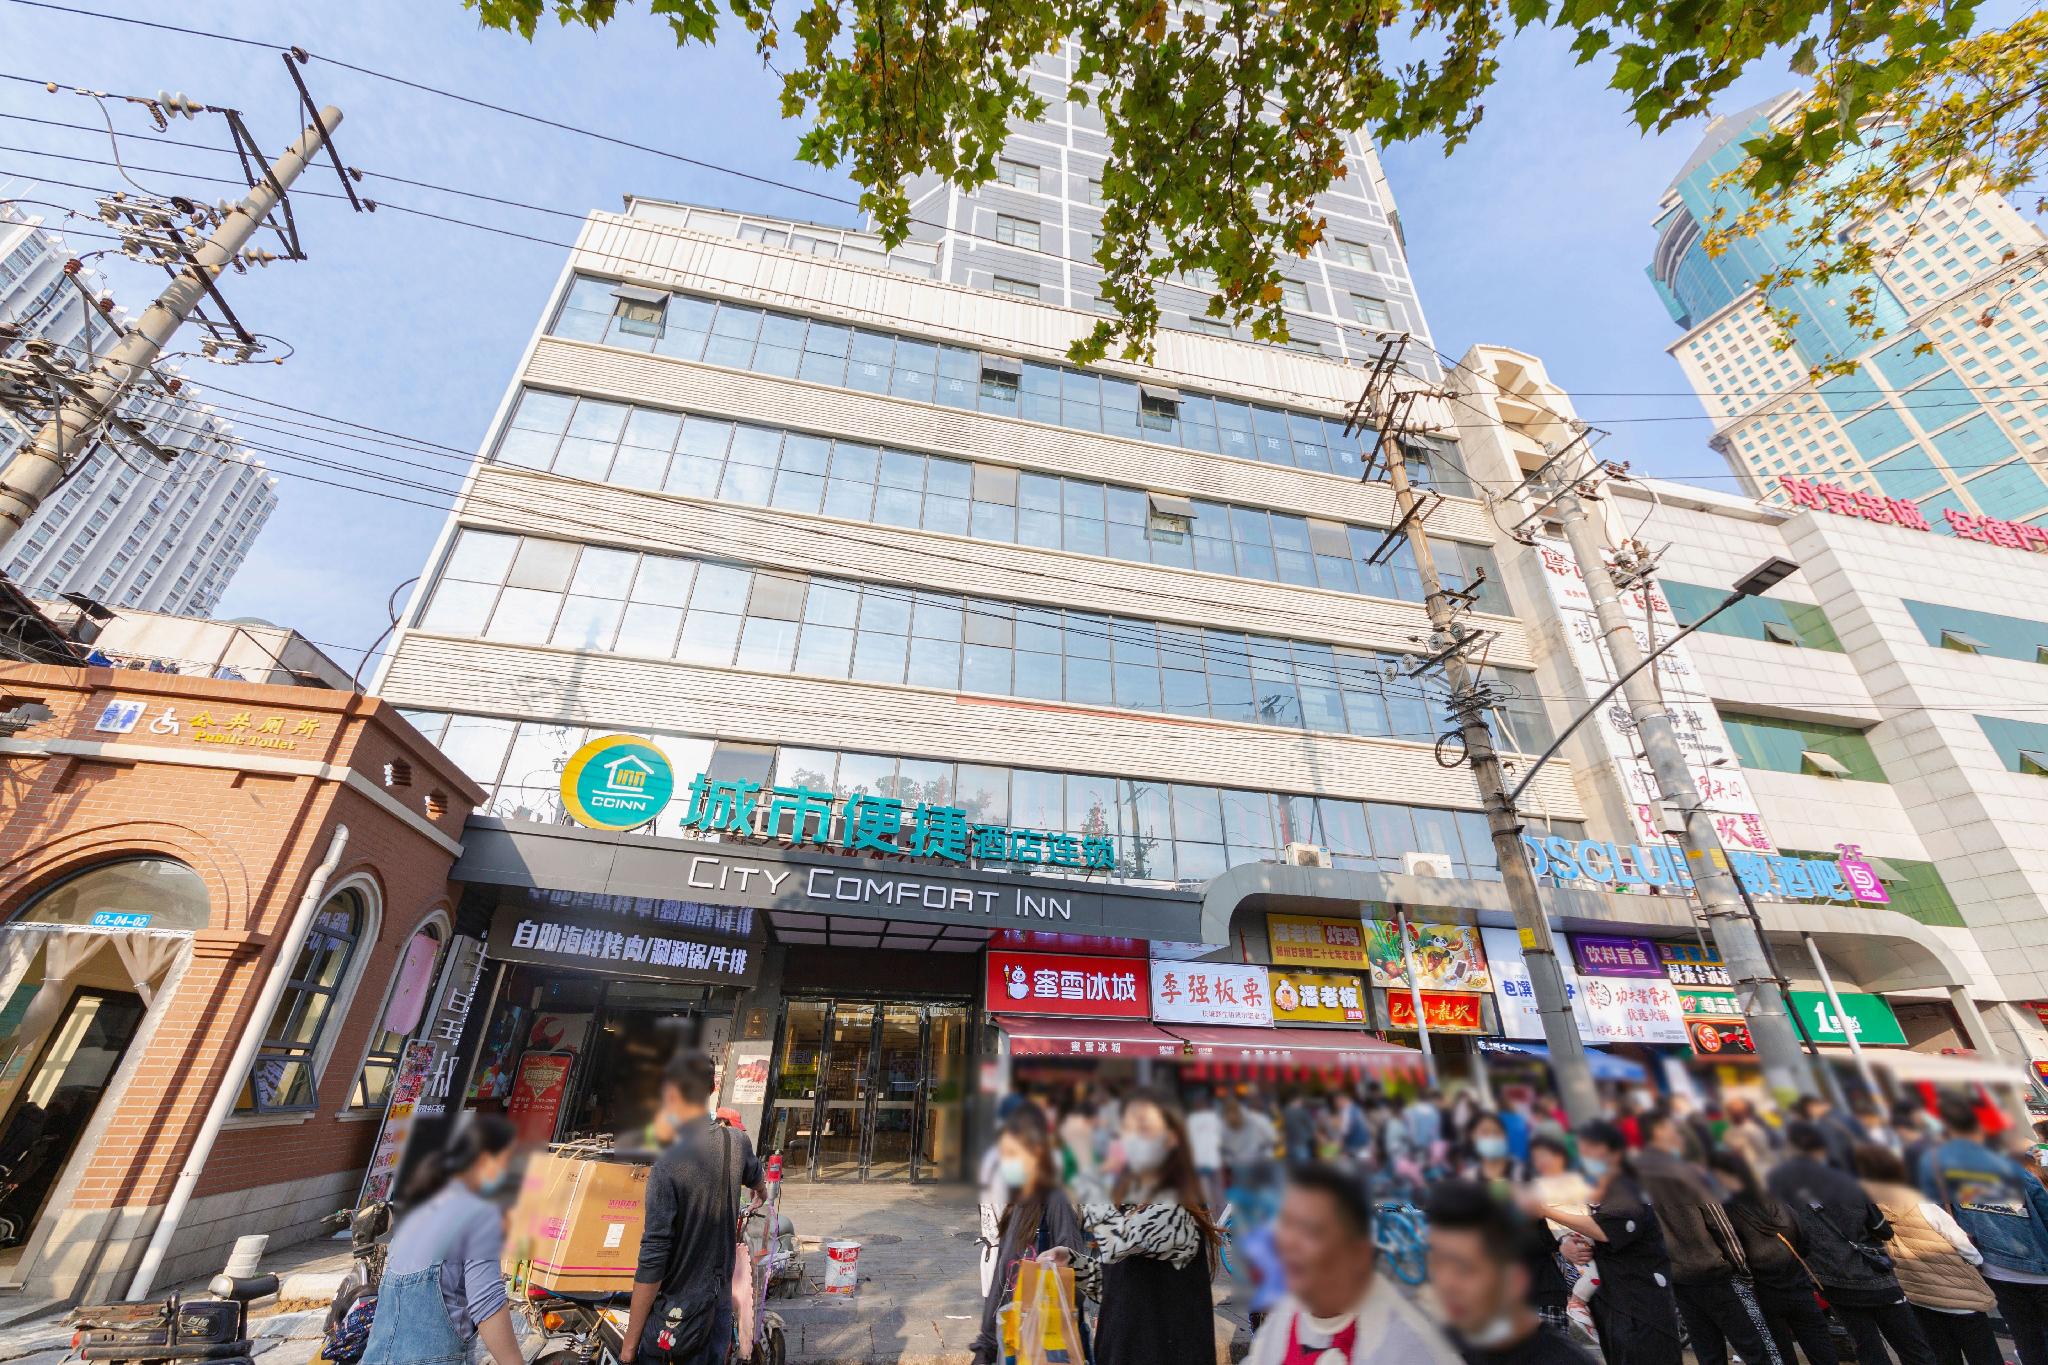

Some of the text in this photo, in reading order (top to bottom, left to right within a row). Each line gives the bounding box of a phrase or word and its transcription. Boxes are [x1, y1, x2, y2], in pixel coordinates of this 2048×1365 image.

[1779, 475, 1931, 531] 对党忠诚
[188, 710, 321, 739] 公共厕所
[194, 730, 298, 750] Public Toilet
[591, 796, 647, 812] CCINN
[680, 771, 1117, 871] 城市便捷 酒店连锁
[687, 855, 1073, 920] CITY COMFORT INN
[94, 914, 148, 927] 02-04-02
[1585, 945, 1650, 966] 饮料盲盒
[1033, 969, 1137, 1003] 蜜雪冰城
[1161, 972, 1263, 1008] 李强板栗
[1298, 985, 1360, 1009] 潘老板
[1071, 1041, 1121, 1054] 蜜雪冰城
